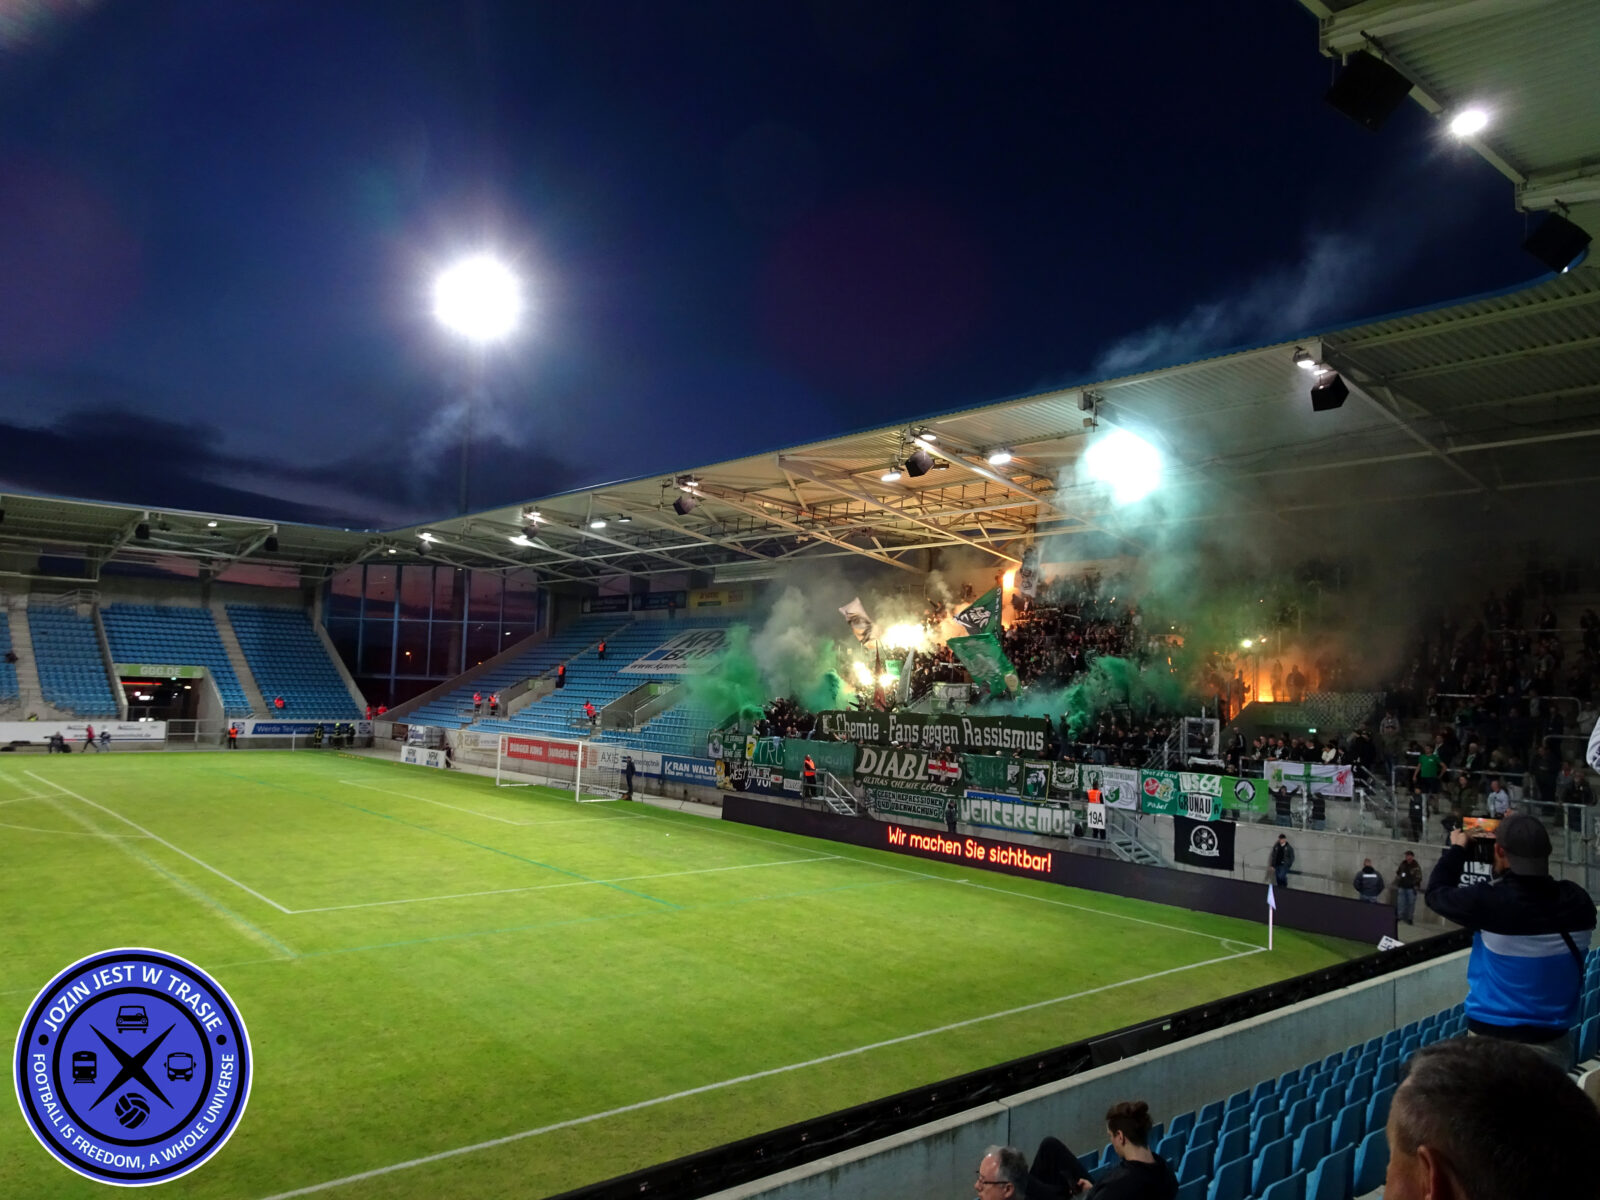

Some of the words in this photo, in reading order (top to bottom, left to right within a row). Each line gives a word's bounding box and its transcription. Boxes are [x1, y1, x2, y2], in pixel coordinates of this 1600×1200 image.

[836, 714, 879, 740] Chemie
[889, 714, 919, 742] Fans
[922, 725, 959, 751] gegen
[962, 718, 1044, 750] Rassismus
[665, 761, 690, 775] KRAN
[863, 776, 889, 787] ULTRAS
[891, 780, 919, 791] CHEMIE
[1088, 811, 1104, 826] 19A
[888, 825, 907, 846] Wir
[909, 834, 962, 856] machen
[965, 838, 986, 860] Sie
[989, 845, 1052, 873] sichtbar!
